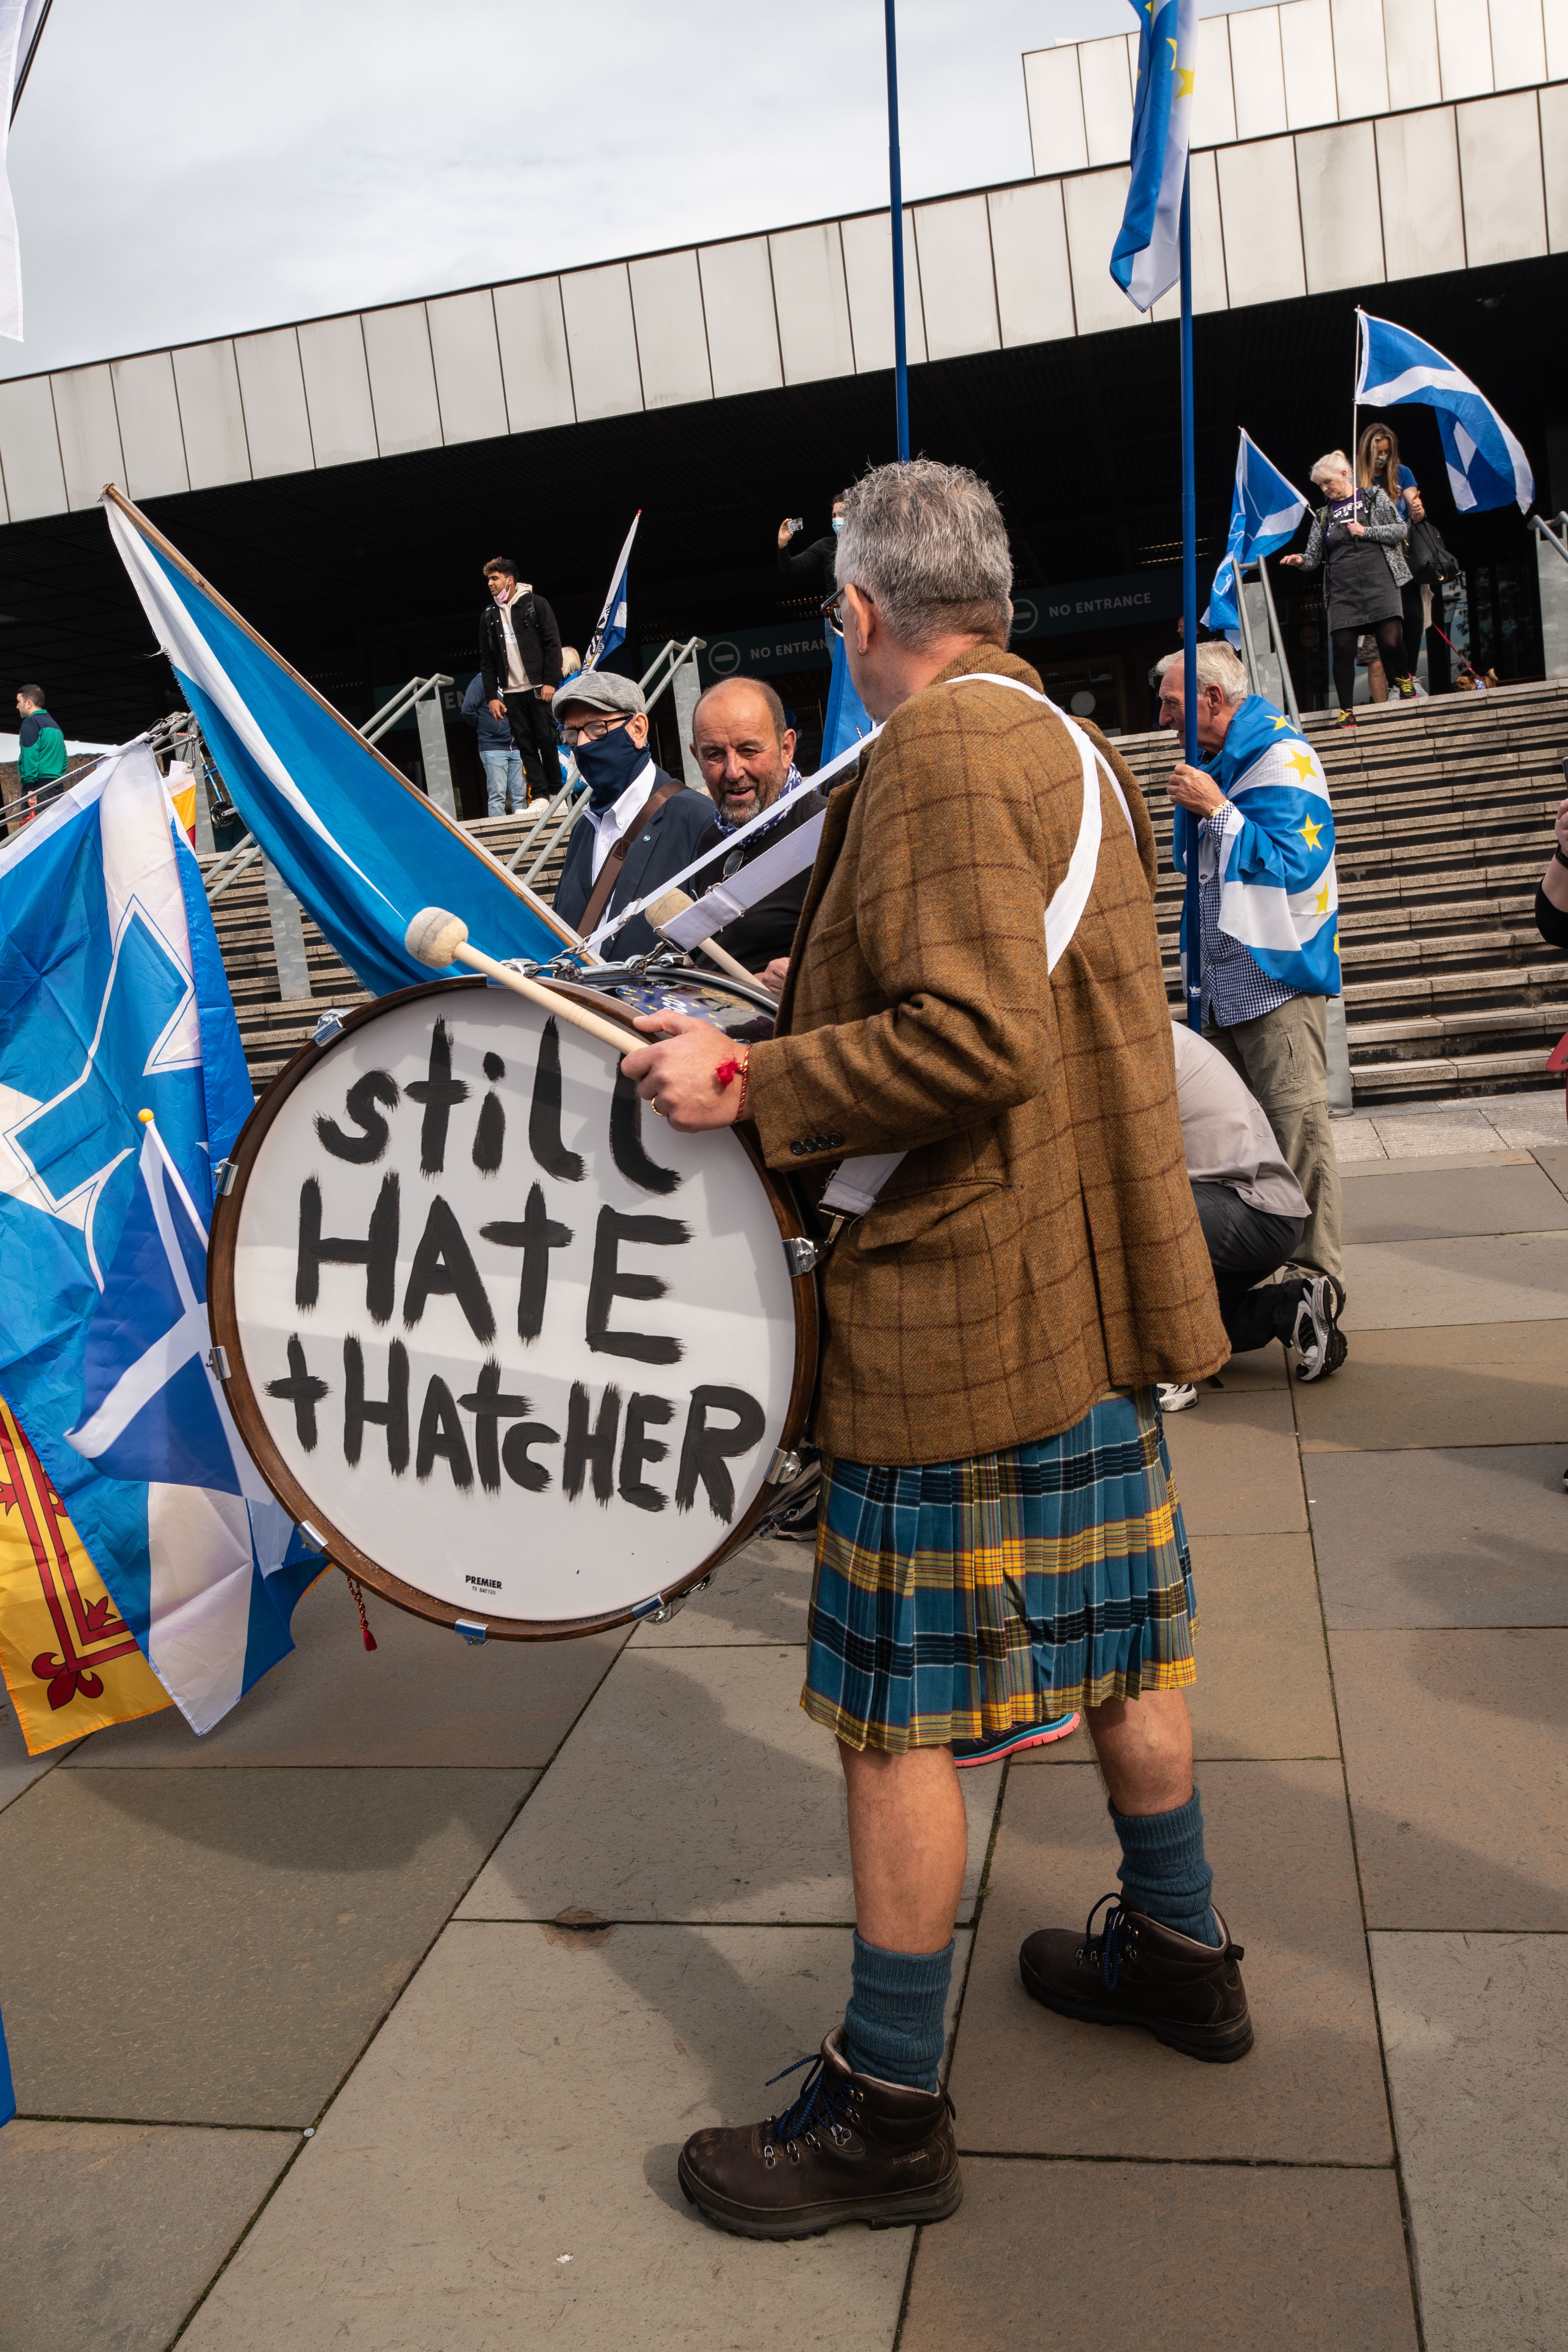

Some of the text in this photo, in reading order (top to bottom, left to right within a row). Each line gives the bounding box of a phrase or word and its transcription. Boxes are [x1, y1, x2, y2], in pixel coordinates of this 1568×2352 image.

[1049, 592, 1151, 617] NO ENTRANCE
[750, 639, 828, 659] NO ENTRAN
[892, 2148, 926, 2164] brasher
